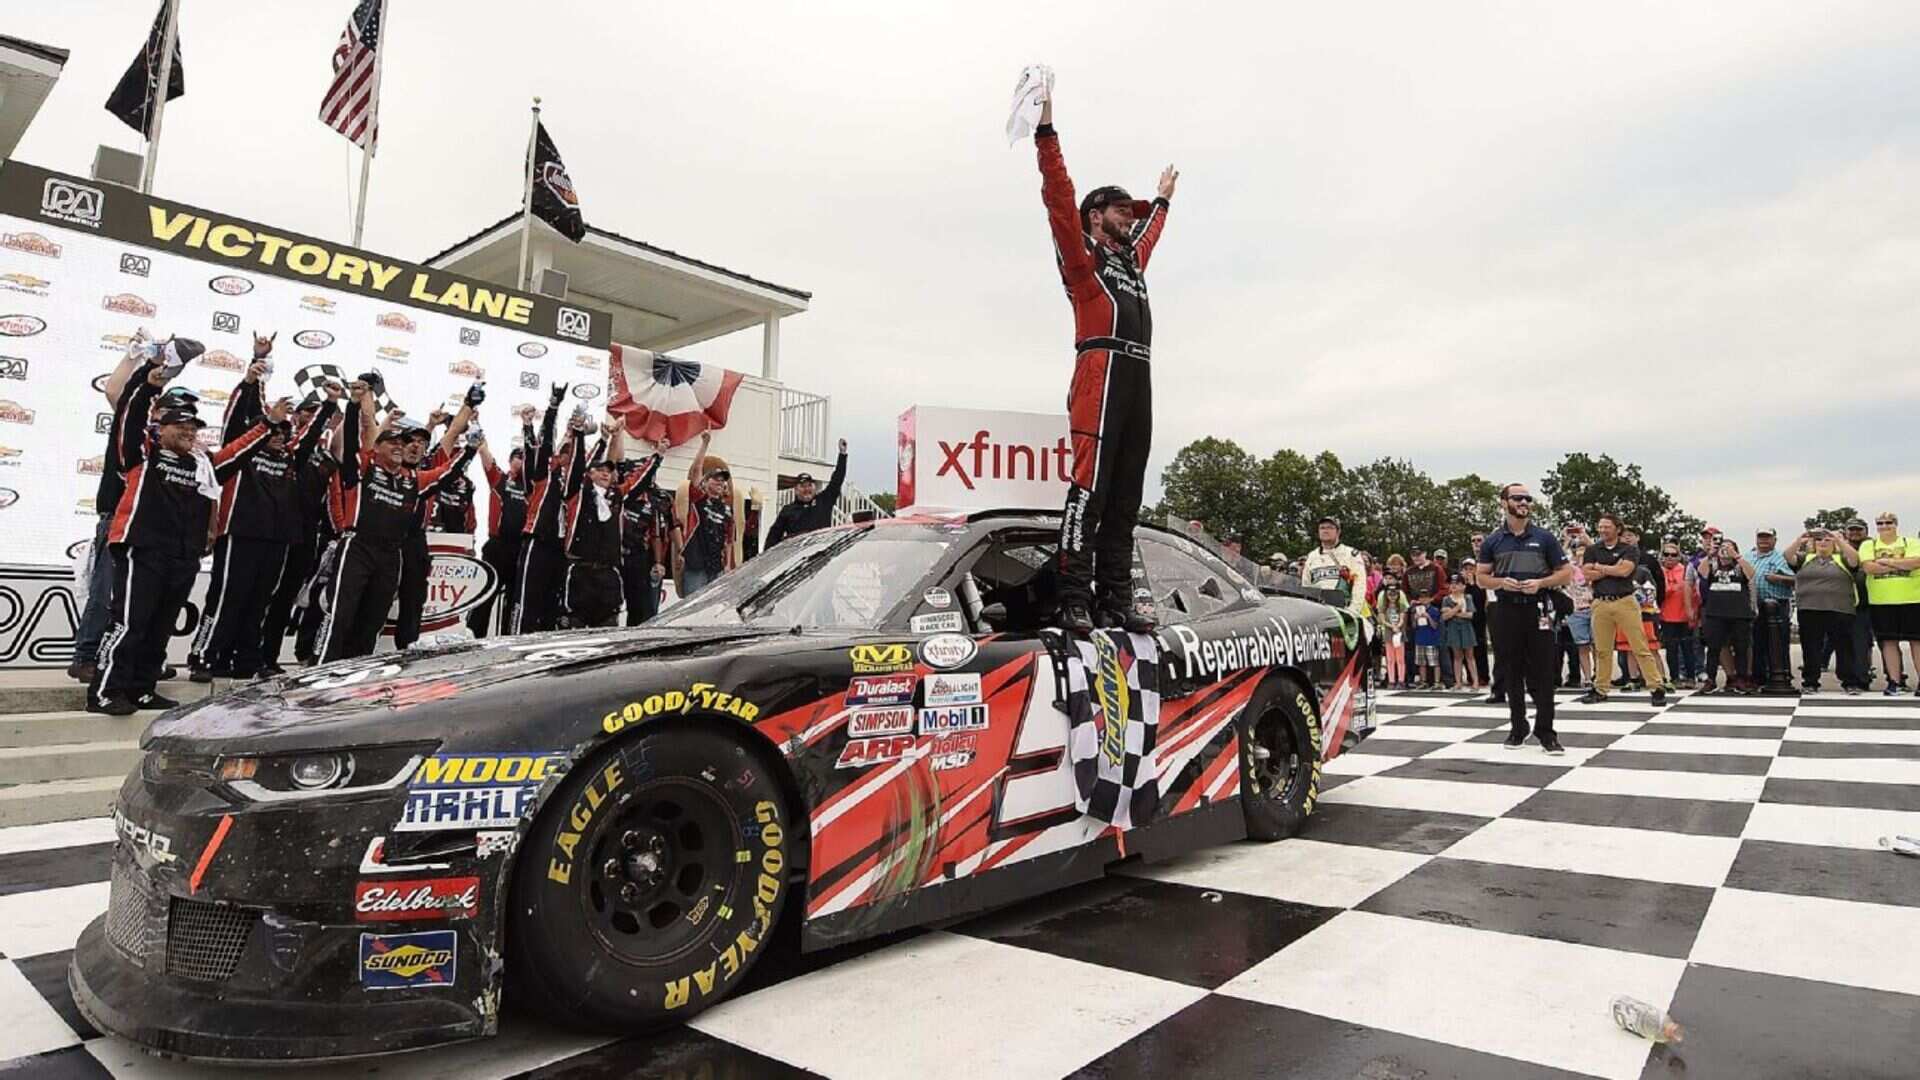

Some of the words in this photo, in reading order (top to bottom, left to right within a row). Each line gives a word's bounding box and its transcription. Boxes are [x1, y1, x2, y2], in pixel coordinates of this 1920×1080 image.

[149, 205, 402, 290] VICTORY
[410, 273, 534, 325] LANE
[936, 430, 1072, 490] xfinit
[855, 678, 911, 696] Duralast
[854, 711, 908, 731] SIMPSON
[924, 708, 967, 729] Mobil
[839, 736, 915, 765] ARP
[930, 753, 971, 770] MSD
[548, 759, 625, 884] EAGLE
[664, 801, 783, 1009] GOODYEAR
[367, 951, 450, 969] SUNOCO
